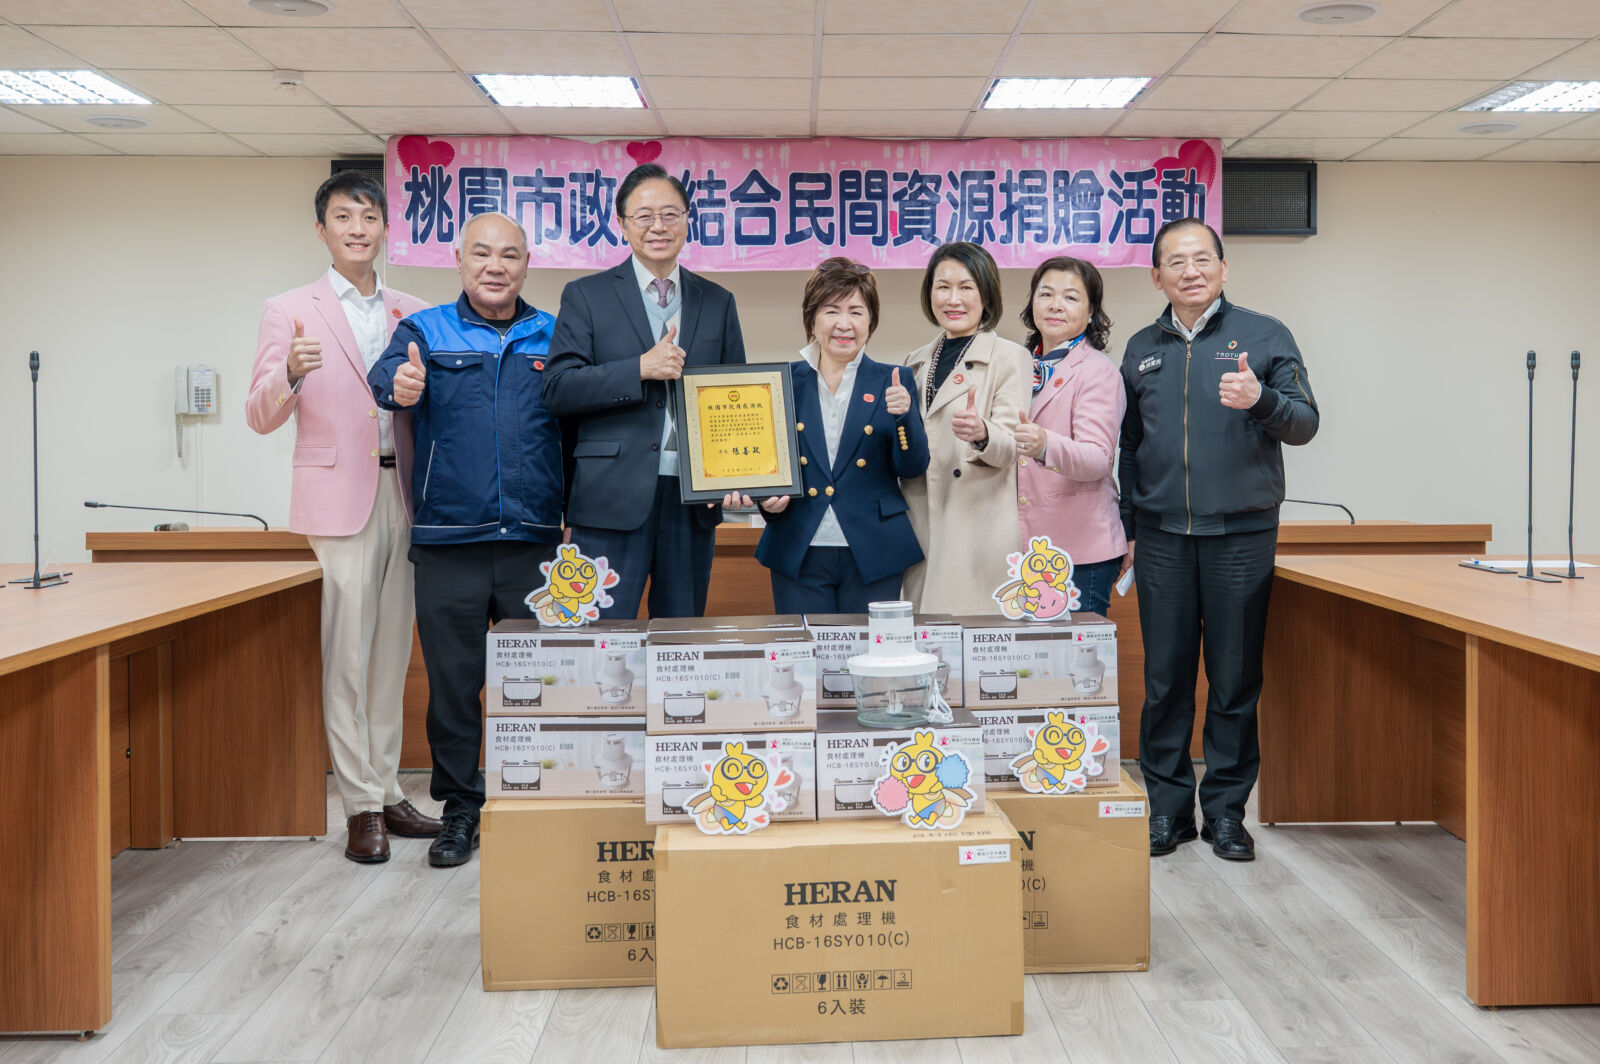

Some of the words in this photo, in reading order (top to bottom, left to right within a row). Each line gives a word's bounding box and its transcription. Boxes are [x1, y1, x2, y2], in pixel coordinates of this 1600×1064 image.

[404, 164, 1207, 247] 桃園市政結合民間資源捐贈活動
[816, 632, 856, 641] HERAN
[973, 633, 1012, 643] HERAN
[496, 639, 538, 648] HERAN
[656, 651, 700, 662] HERAN
[972, 654, 1031, 662] HCB-16SY010(C)
[656, 674, 721, 682] HCB-16SY010(C)
[977, 716, 1014, 725] HERAN
[496, 723, 537, 732] HERAN
[495, 744, 556, 752] HCB-16SY010(C)
[656, 742, 698, 751] HERAN
[827, 738, 869, 748] HERAN
[1019, 831, 1035, 851] N
[587, 889, 655, 903] HCB-16S
[784, 879, 897, 906] HERAN
[785, 911, 896, 929] 食材處理機
[773, 930, 910, 950] HCB-16SY010(C)
[818, 998, 866, 1016] 6入裝
